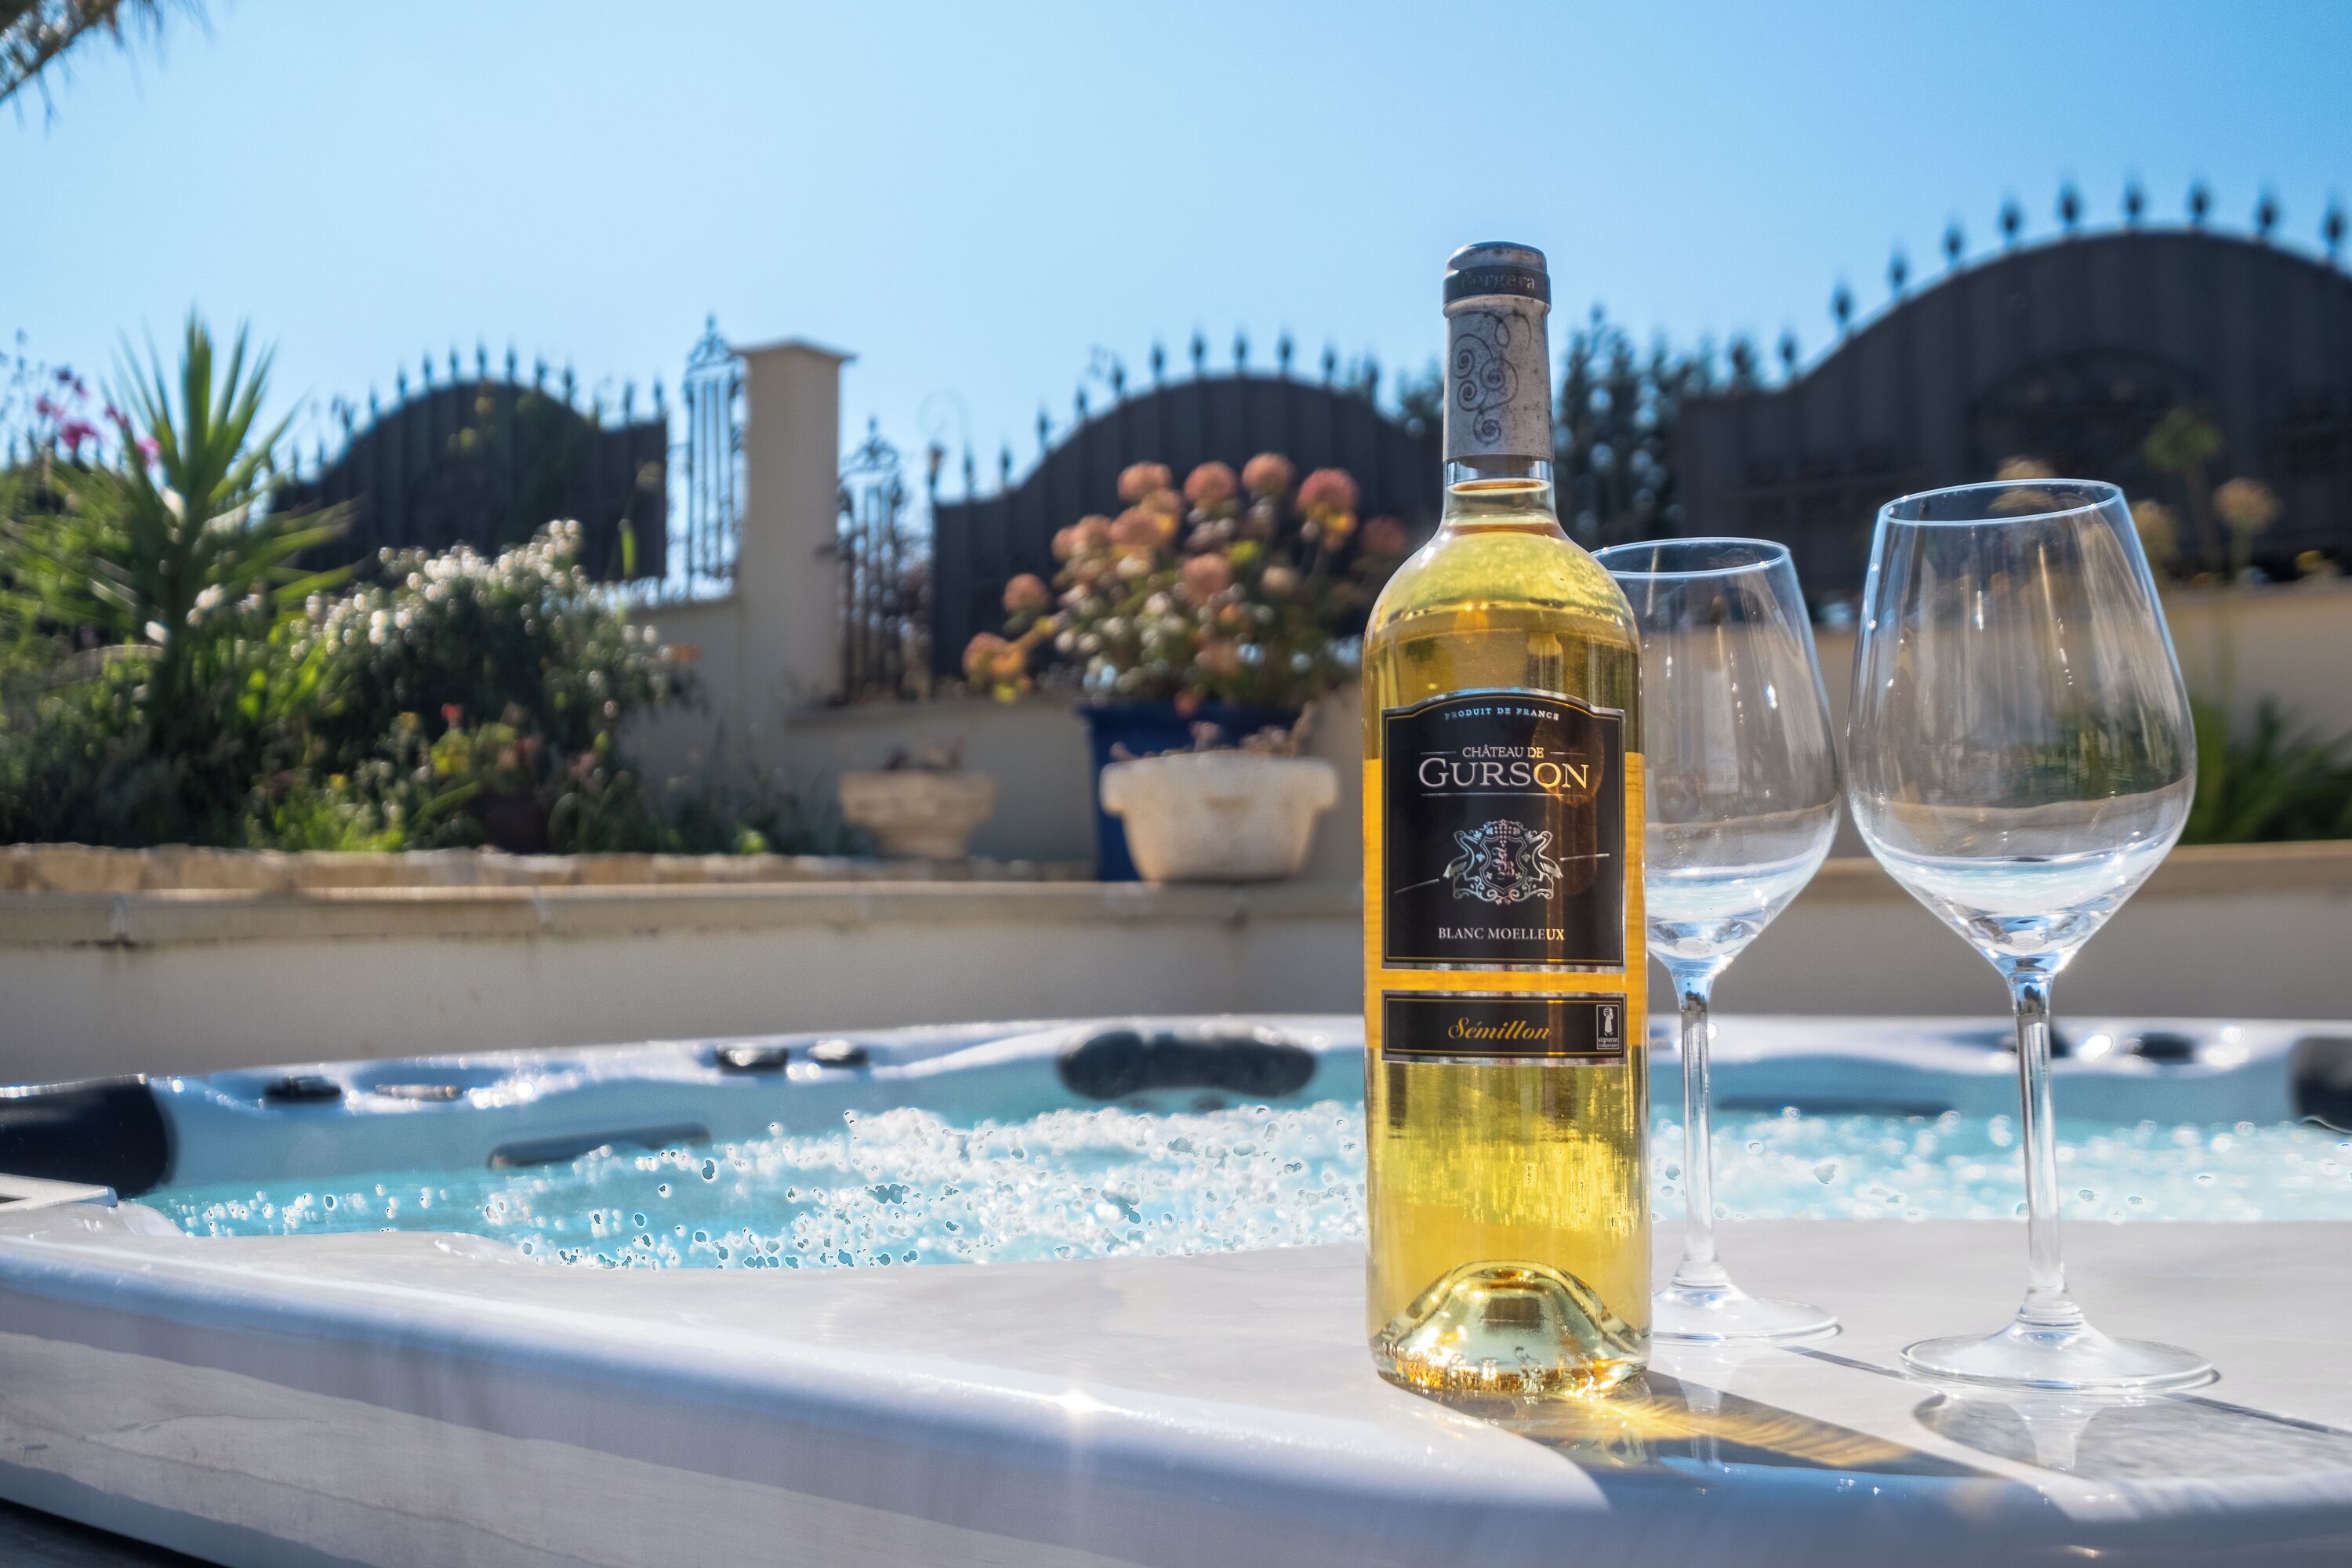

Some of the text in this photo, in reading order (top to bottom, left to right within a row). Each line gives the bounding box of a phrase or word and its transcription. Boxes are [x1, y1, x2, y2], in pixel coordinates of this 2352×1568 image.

[1444, 707, 1491, 720] PRODUIT
[1516, 707, 1559, 720] FRANCE
[1462, 744, 1544, 759] CHÂTEAU DE
[1418, 757, 1589, 789] GURSON
[1438, 927, 1565, 941] BLANC MOELLEUX
[1448, 1016, 1552, 1040] Sémillon
